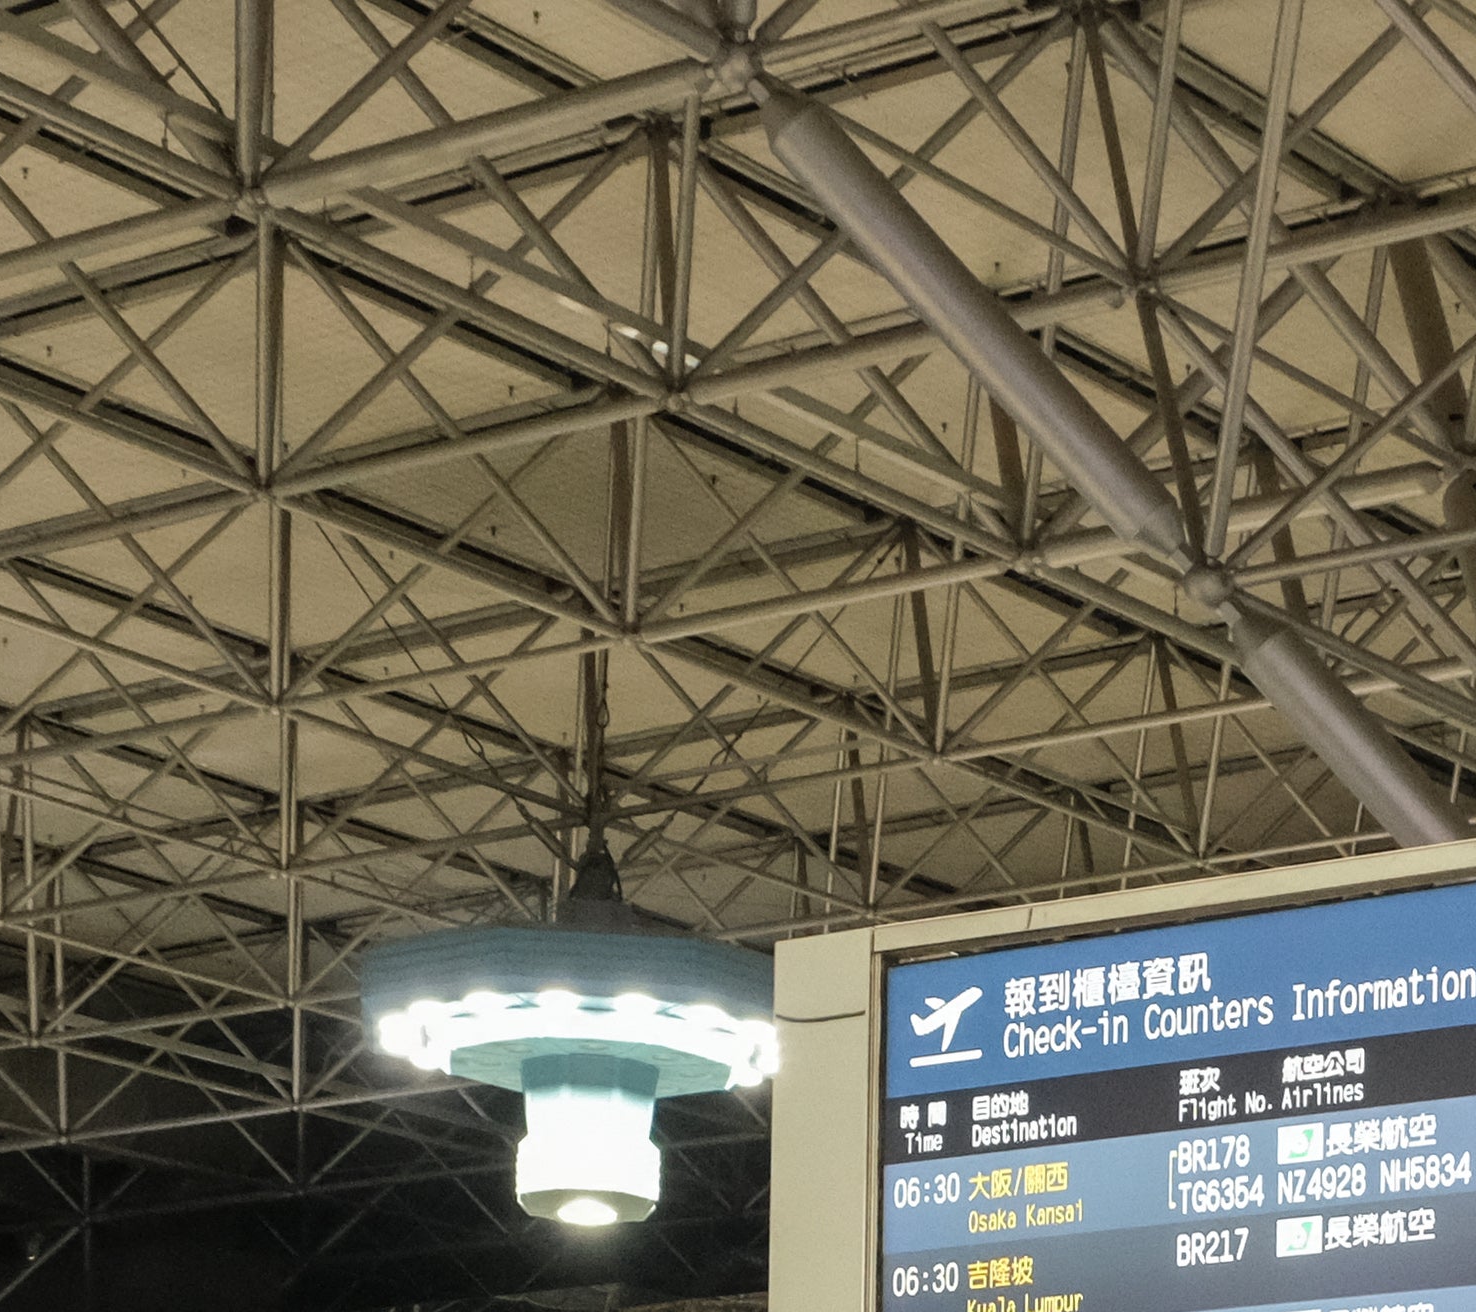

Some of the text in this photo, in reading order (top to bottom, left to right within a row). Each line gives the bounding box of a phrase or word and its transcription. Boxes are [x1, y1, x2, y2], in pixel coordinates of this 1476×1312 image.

[1004, 952, 1212, 1020] 報到櫃檯資訊
[1003, 966, 1476, 1059] Check-in Counters Information
[1281, 1047, 1365, 1084] 航空公司
[972, 1089, 1029, 1122] 目的地
[1178, 1090, 1272, 1122] Flight No.
[1281, 1082, 1364, 1110] Airlines
[904, 1131, 943, 1154] Time
[972, 1114, 1077, 1147] Destination
[1379, 1150, 1472, 1194] NH5834
[968, 1198, 1083, 1234] Osaka Kansai
